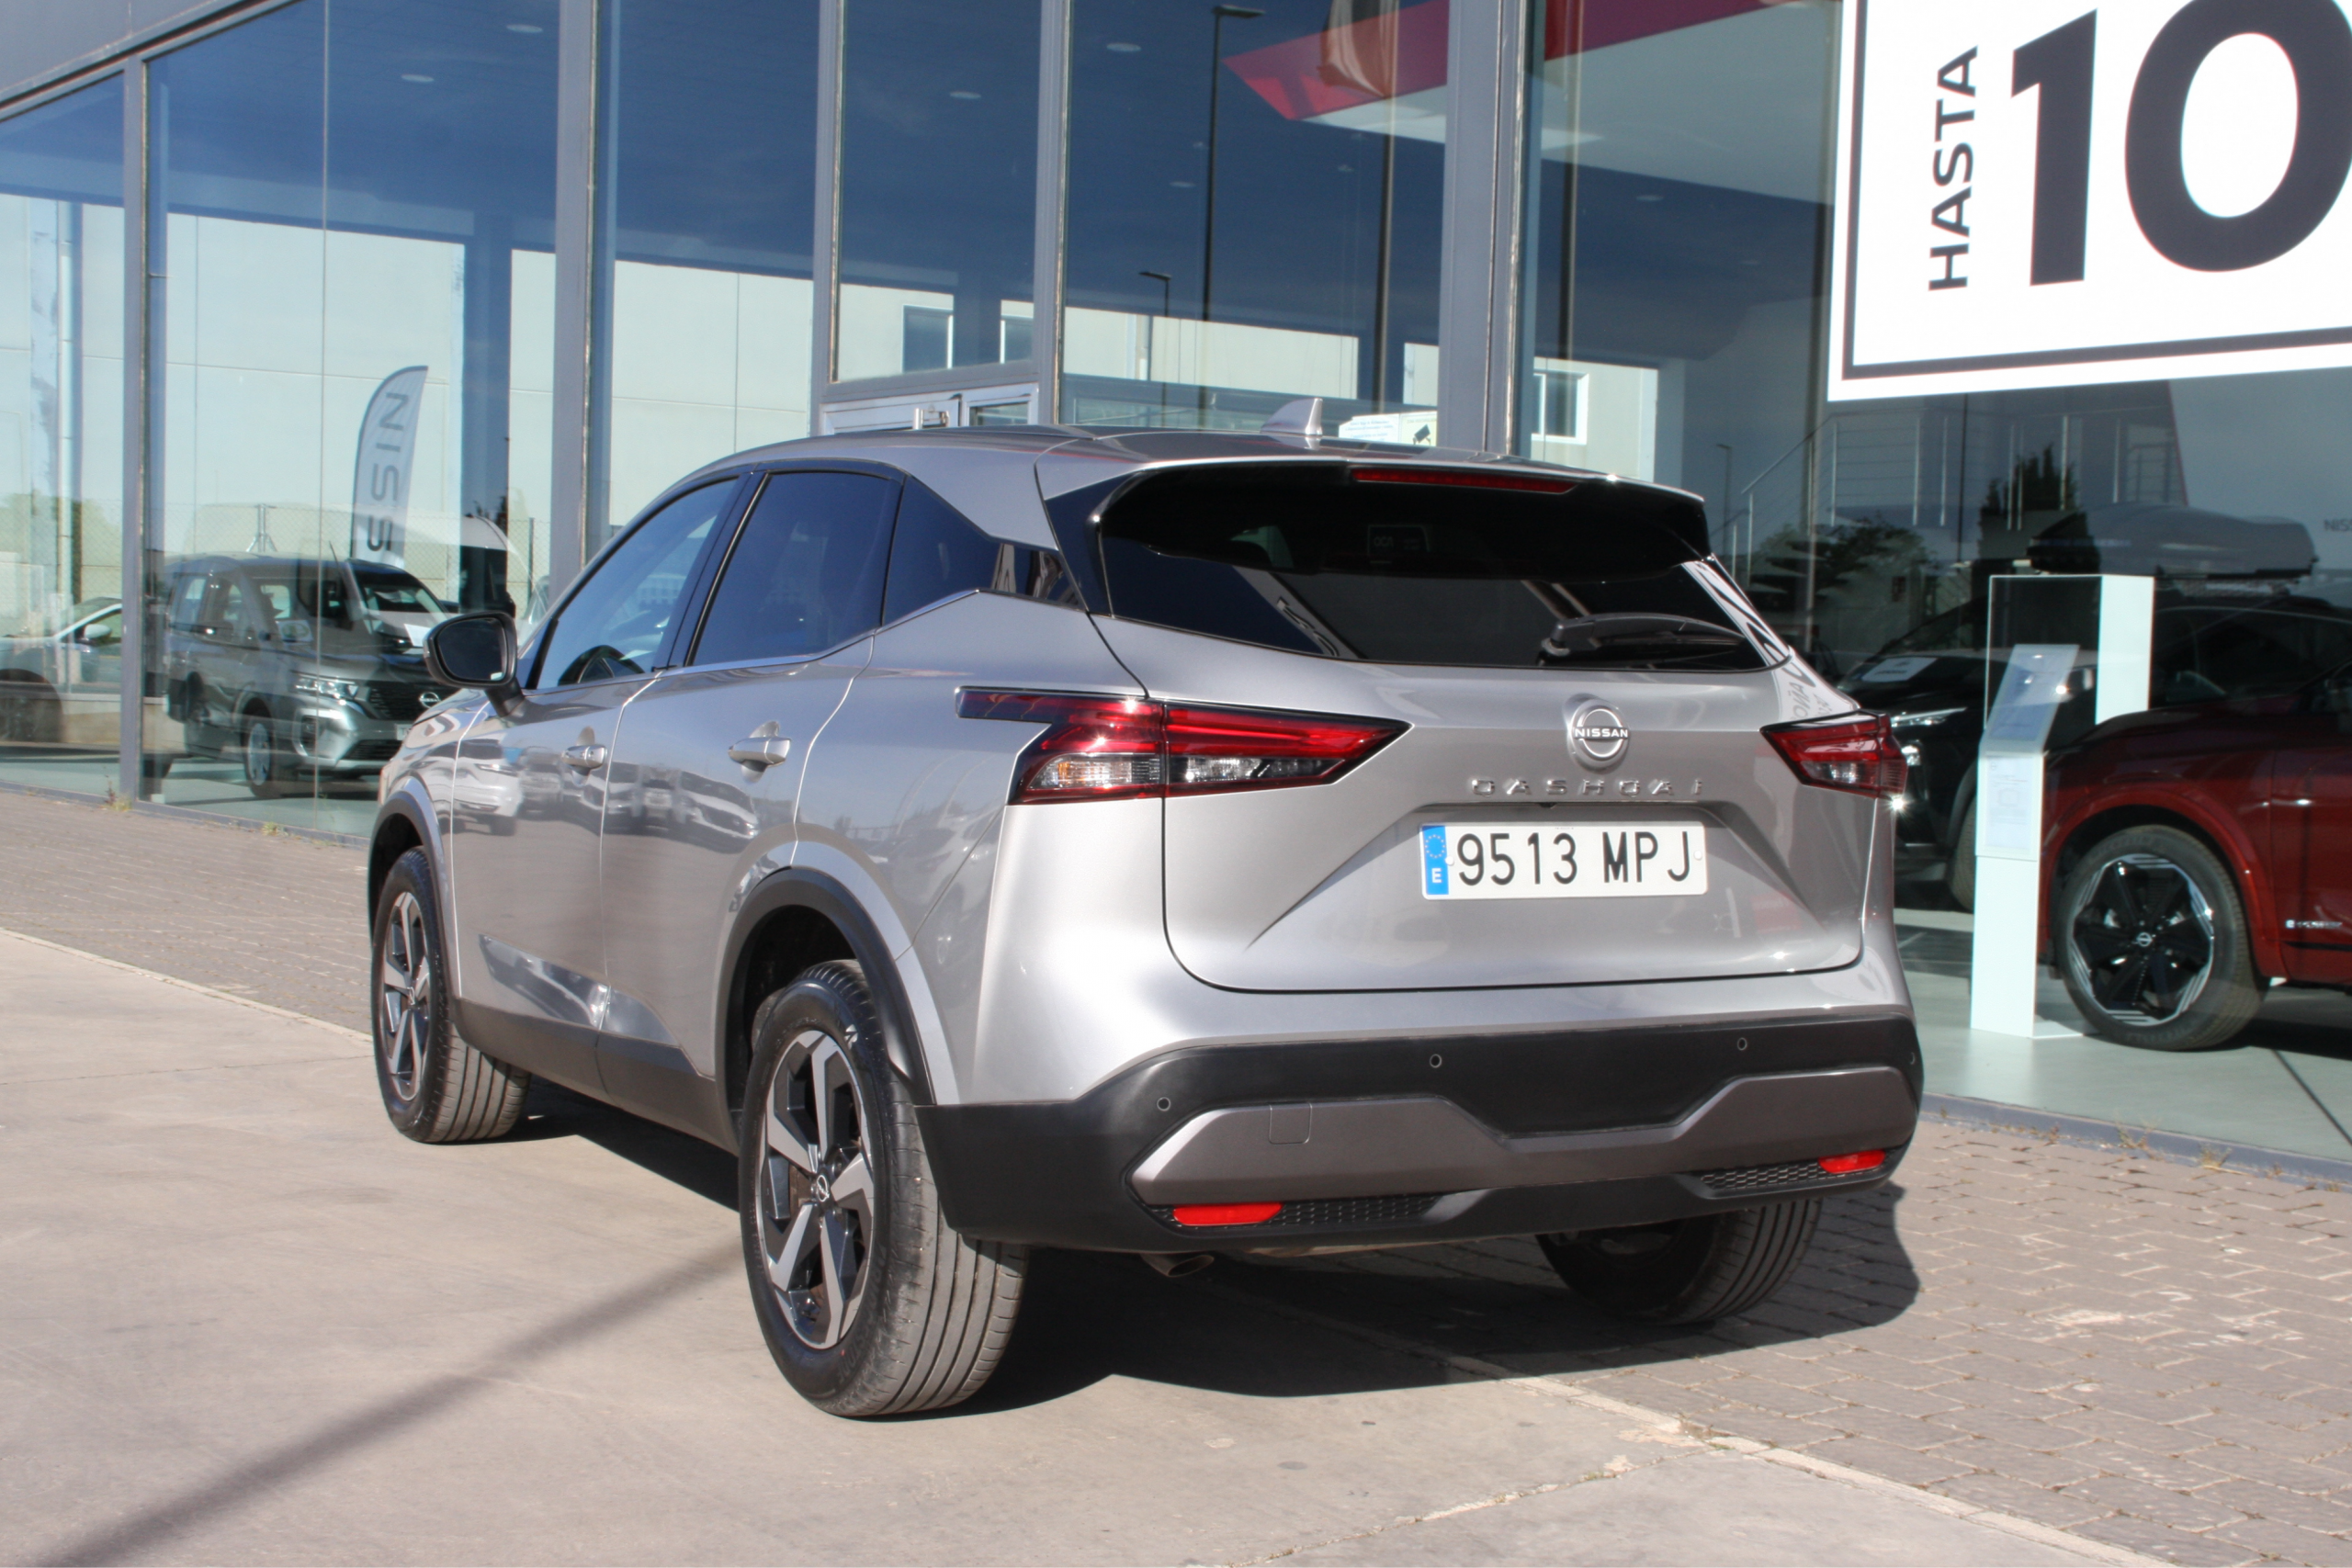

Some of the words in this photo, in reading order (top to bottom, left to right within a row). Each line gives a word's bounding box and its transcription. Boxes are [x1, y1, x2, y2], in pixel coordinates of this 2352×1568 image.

[2010, 0, 2352, 286] 10
[1928, 45, 1978, 291] HASTA
[2324, 518, 2352, 532] NIS
[1575, 728, 1629, 738] NISSAN
[1472, 779, 1702, 797] QASHQAI
[1456, 832, 1578, 886] 9513
[1602, 830, 1690, 884] MPJ
[1431, 867, 1442, 884] E
